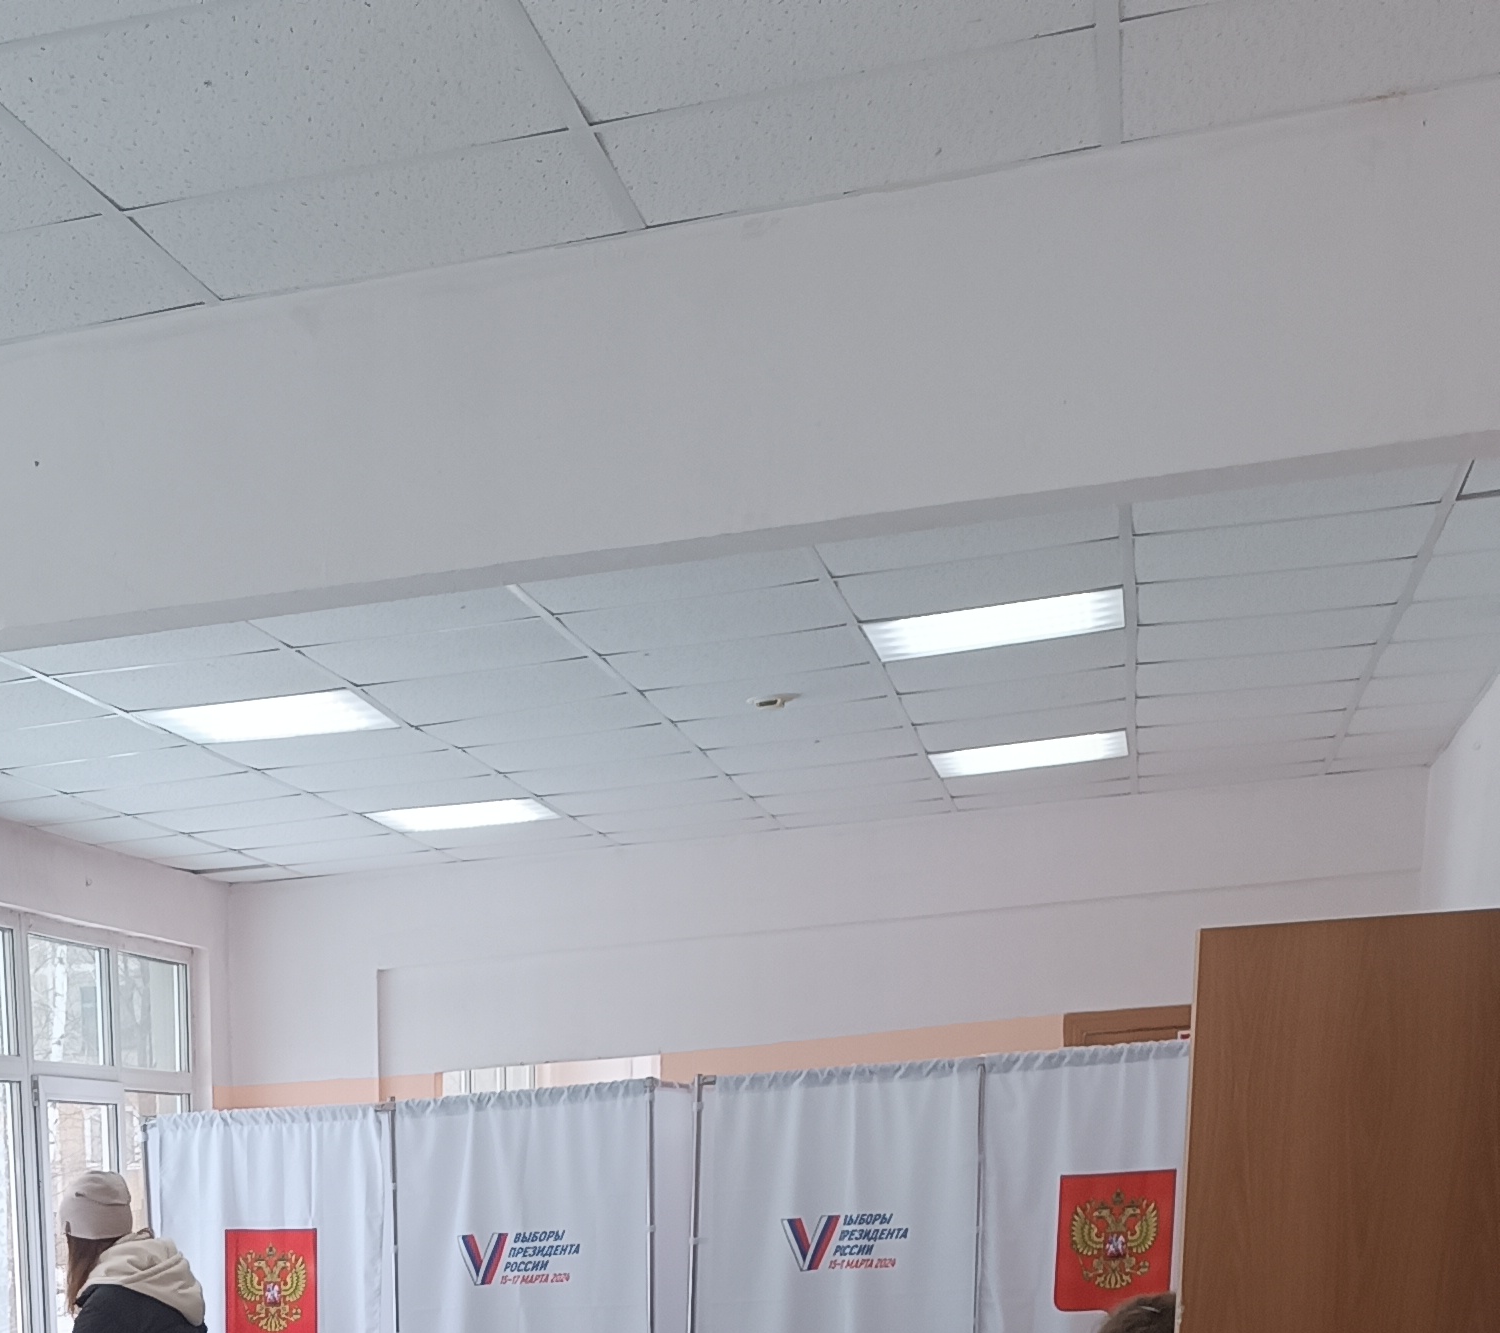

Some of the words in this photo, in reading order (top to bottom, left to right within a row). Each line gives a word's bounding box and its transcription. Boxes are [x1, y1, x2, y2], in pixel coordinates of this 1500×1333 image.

[513, 1230, 565, 1243] ВЫБОРЫ
[507, 1243, 580, 1258] ПРЕЗИДЕНТА
[503, 1260, 549, 1272] РОССИИ
[845, 1258, 873, 1269] МАРТА
[875, 1258, 896, 1268] 2024
[520, 1273, 549, 1284] МАРТА
[550, 1273, 571, 1283] 2024
